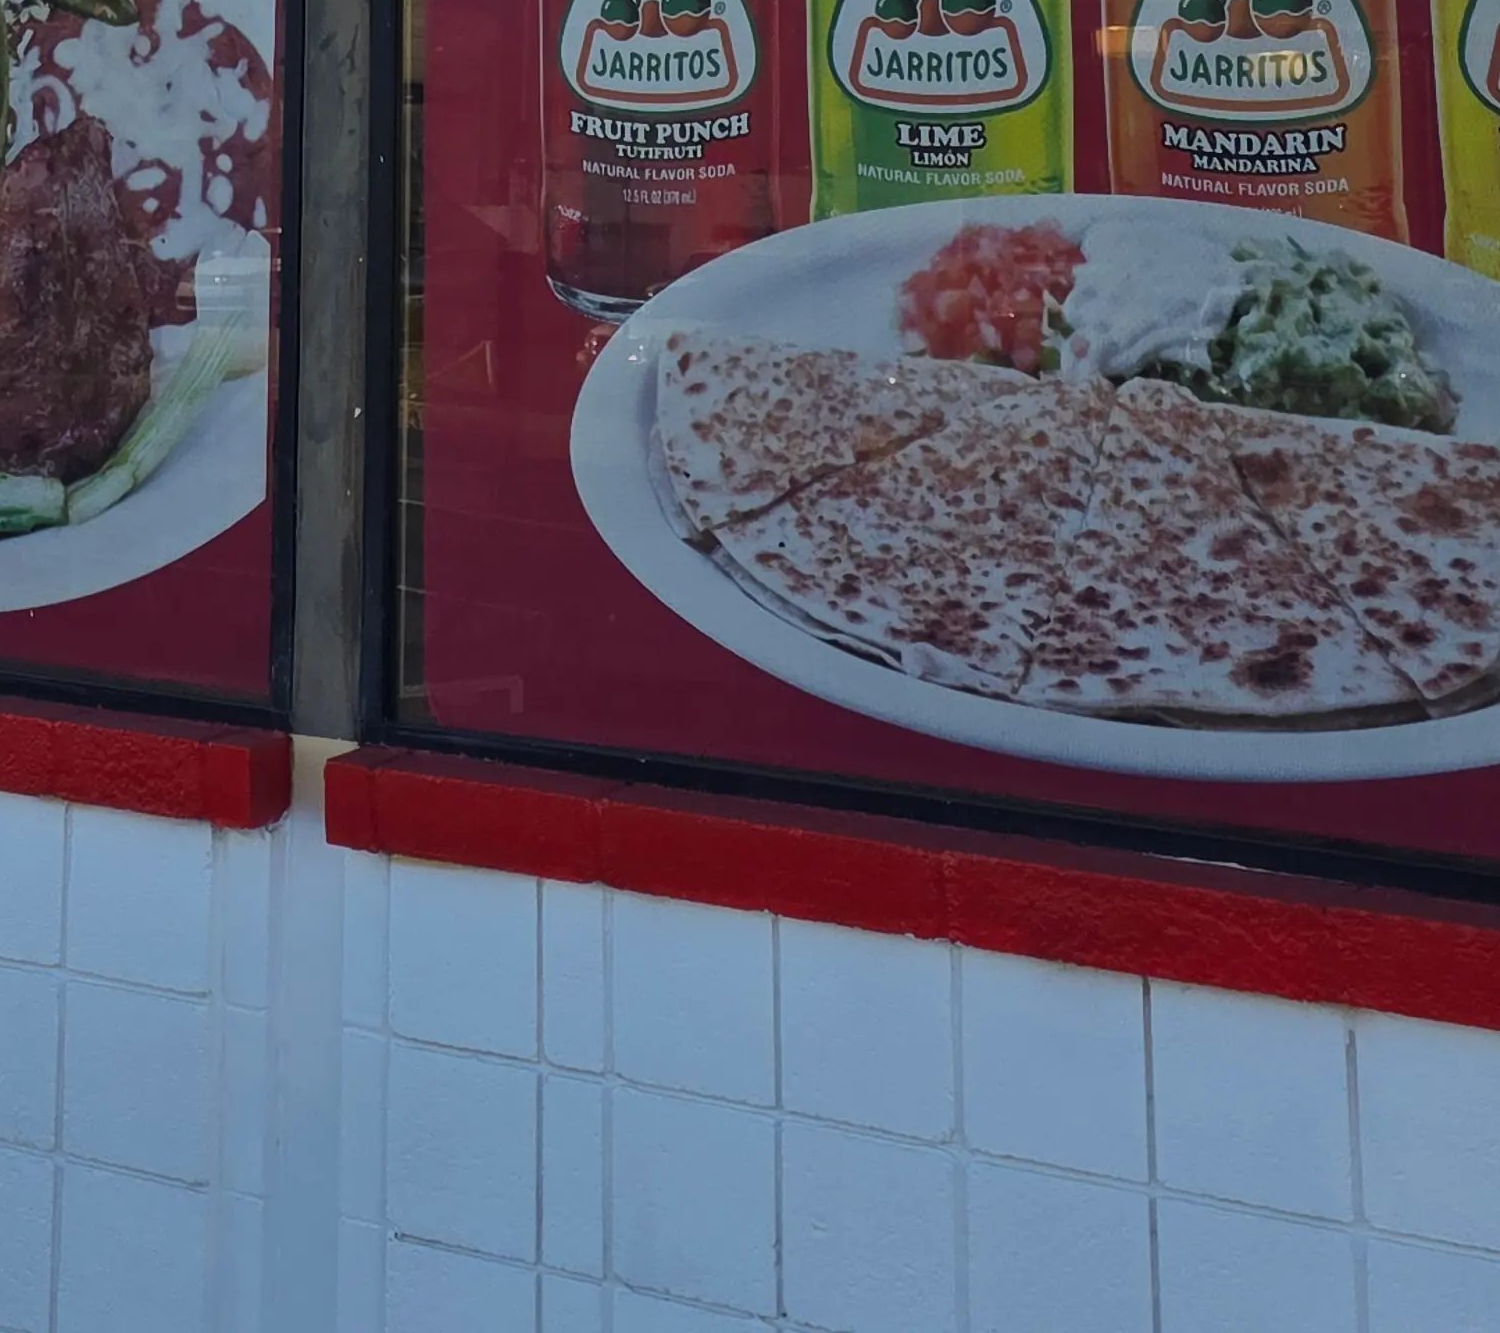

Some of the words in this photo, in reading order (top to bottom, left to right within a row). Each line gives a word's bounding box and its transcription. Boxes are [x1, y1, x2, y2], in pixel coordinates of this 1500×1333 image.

[592, 48, 721, 82] JARRITOS
[866, 47, 1009, 83] JARRITOS
[1169, 50, 1328, 88] JARRITOS
[570, 111, 650, 143] FRUIT
[655, 113, 749, 144] PUNCH
[897, 123, 985, 147] LIME
[1163, 123, 1344, 156] MANDARIN
[616, 144, 703, 160] TUTIFRUTI
[913, 149, 969, 166] LIMÓN
[1193, 154, 1317, 173] MANDARINA
[583, 160, 640, 180] NATURAL
[645, 168, 695, 181] FLAVOR
[698, 163, 736, 178] SODA
[858, 163, 921, 184] NATURAL
[926, 172, 980, 186] FLAVOR
[985, 169, 1025, 184] SODA
[1162, 172, 1233, 194] NATURAL
[1238, 182, 1300, 196] FLAVOR
[1304, 178, 1349, 195] SODA
